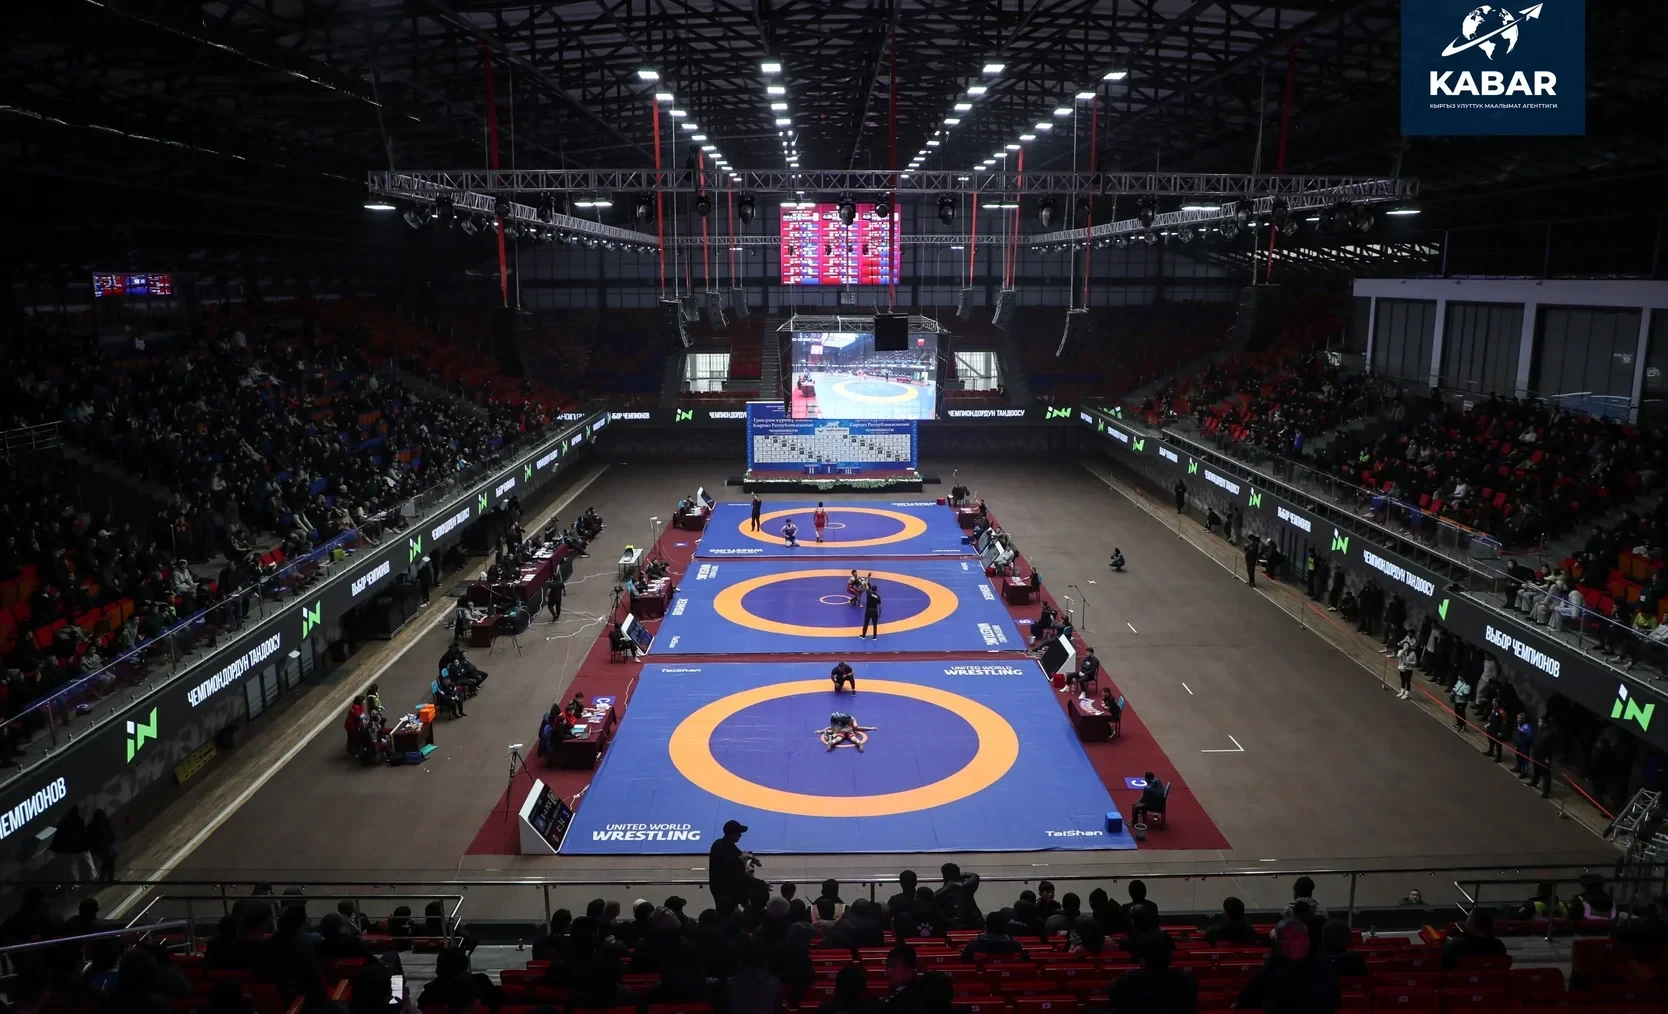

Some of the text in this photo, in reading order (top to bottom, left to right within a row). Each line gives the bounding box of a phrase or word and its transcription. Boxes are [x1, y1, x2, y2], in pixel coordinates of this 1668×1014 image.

[1363, 549, 1435, 597] ЧЕМПИОНДОРДУН ТАНДООСУ
[187, 632, 281, 707] ЧЕМПИОНДОРДУН ТАНДООСУ
[1485, 625, 1560, 678] ВЫБОР ЧЕМПИОНОВ
[592, 831, 701, 841] WRESTLING
[606, 823, 691, 831] UNITED WORLD
